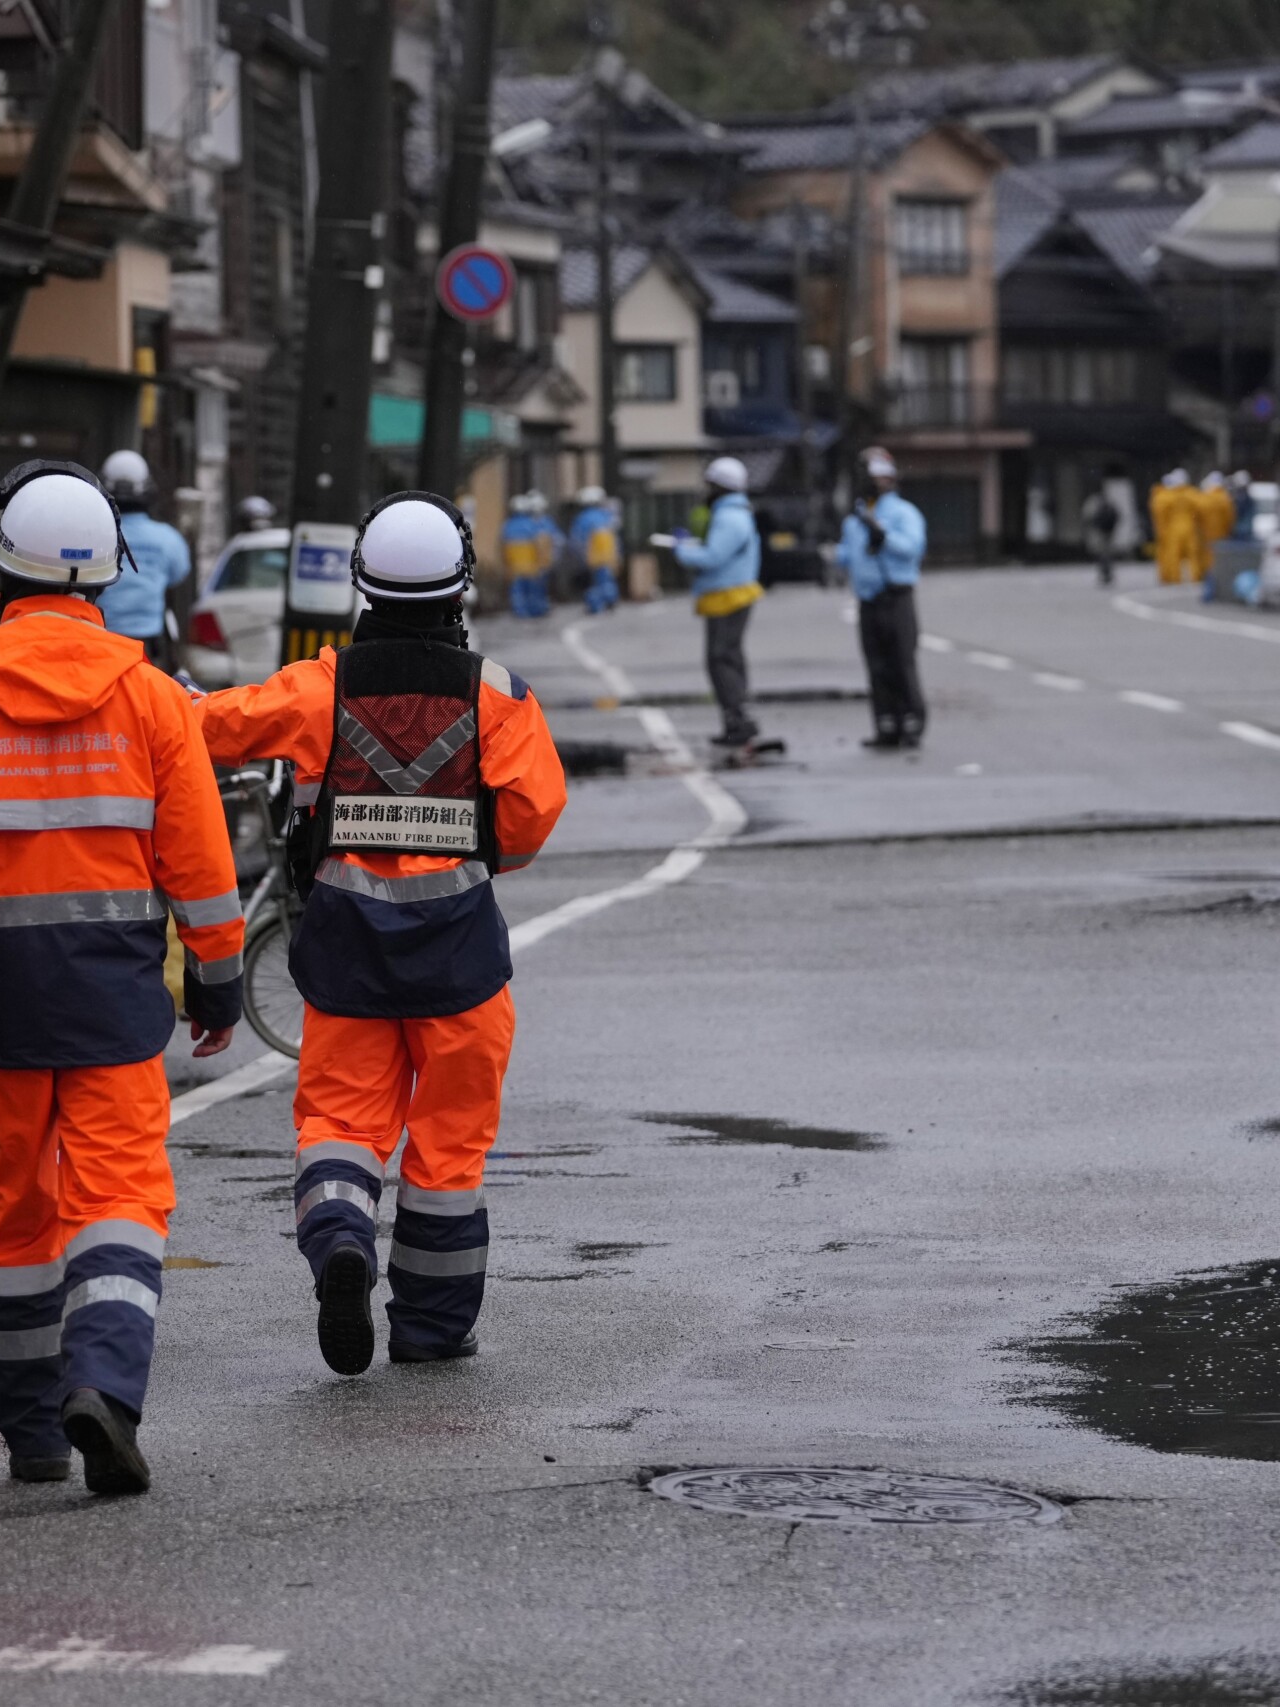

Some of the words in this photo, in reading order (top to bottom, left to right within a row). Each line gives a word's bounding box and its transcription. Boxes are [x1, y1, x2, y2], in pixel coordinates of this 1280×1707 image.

[56, 764, 83, 775] FIRE
[86, 762, 120, 774] DEPT.
[334, 803, 475, 827] 海部南部消防組合
[334, 831, 401, 842] AMANANBU
[404, 833, 433, 843] FIRE
[436, 835, 470, 846] DEPT.
